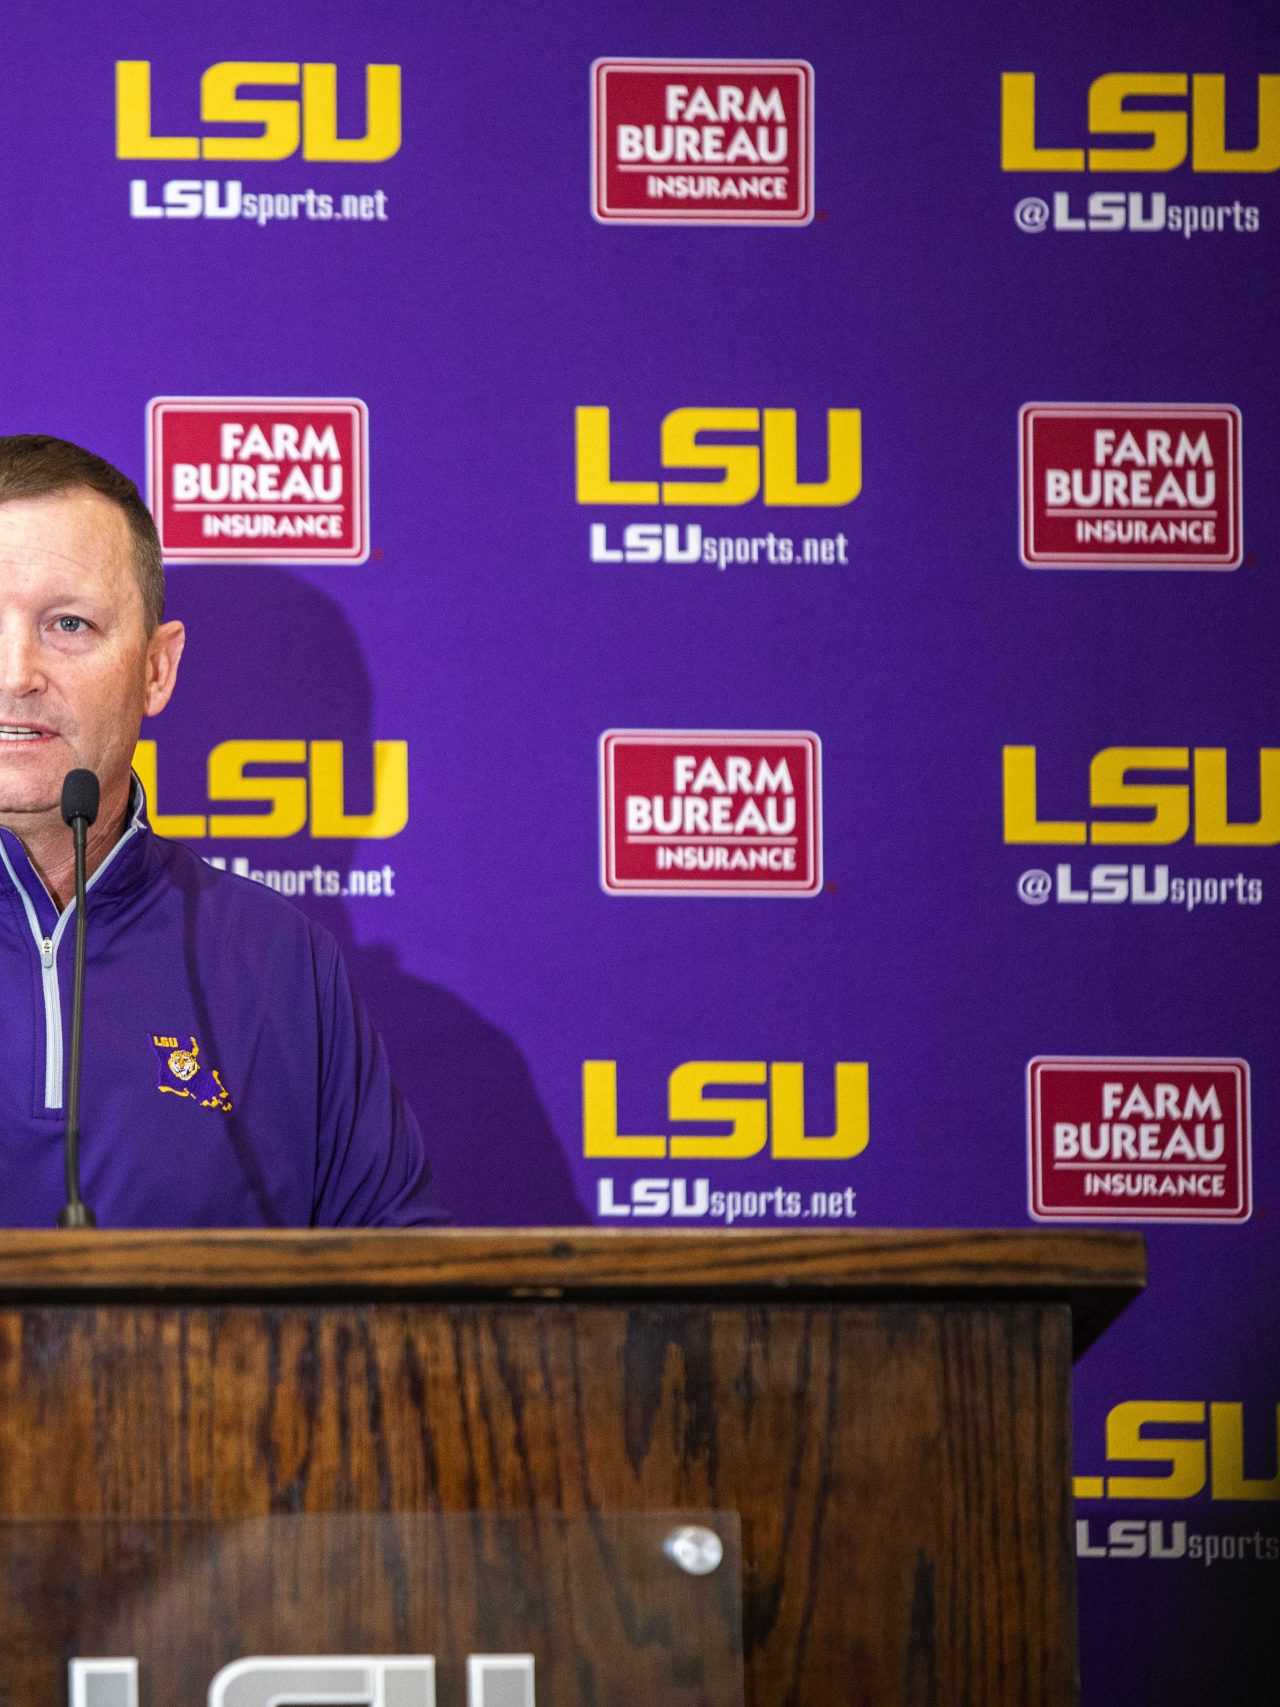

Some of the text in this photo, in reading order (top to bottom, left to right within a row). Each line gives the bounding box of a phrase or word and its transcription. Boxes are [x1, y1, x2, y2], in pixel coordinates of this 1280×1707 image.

[116, 61, 401, 162] LSU
[667, 85, 785, 122] FARM
[1001, 72, 1280, 172] LSU
[618, 125, 787, 163] BUREAU
[131, 180, 386, 224] LSUsports.net
[648, 176, 786, 199] INSURANCE
[1015, 192, 1259, 238] @LSUsports
[222, 424, 340, 461] FARM
[576, 406, 861, 505] LSU
[1095, 430, 1213, 466] FARM
[174, 464, 342, 501] BUREAU
[1046, 470, 1215, 508] BUREAU
[203, 515, 342, 537] INSURANCE
[1077, 520, 1215, 543] INSURANCE
[591, 524, 847, 569] LSUsports.net
[131, 740, 408, 838] LSU
[675, 756, 793, 794] FARM
[1003, 745, 1280, 845] LSU
[627, 796, 795, 835] BUREAU
[657, 847, 795, 870] INSURANCE
[1018, 864, 1262, 910] @LSUsports
[153, 1035, 178, 1048] LSU
[583, 1060, 869, 1159] LSU
[1103, 1083, 1221, 1120] FARM
[1054, 1123, 1224, 1161] BUREAU
[598, 1178, 856, 1223] LSUsports.net
[1085, 1174, 1225, 1196] INSURANCE
[1072, 1401, 1280, 1499] SU
